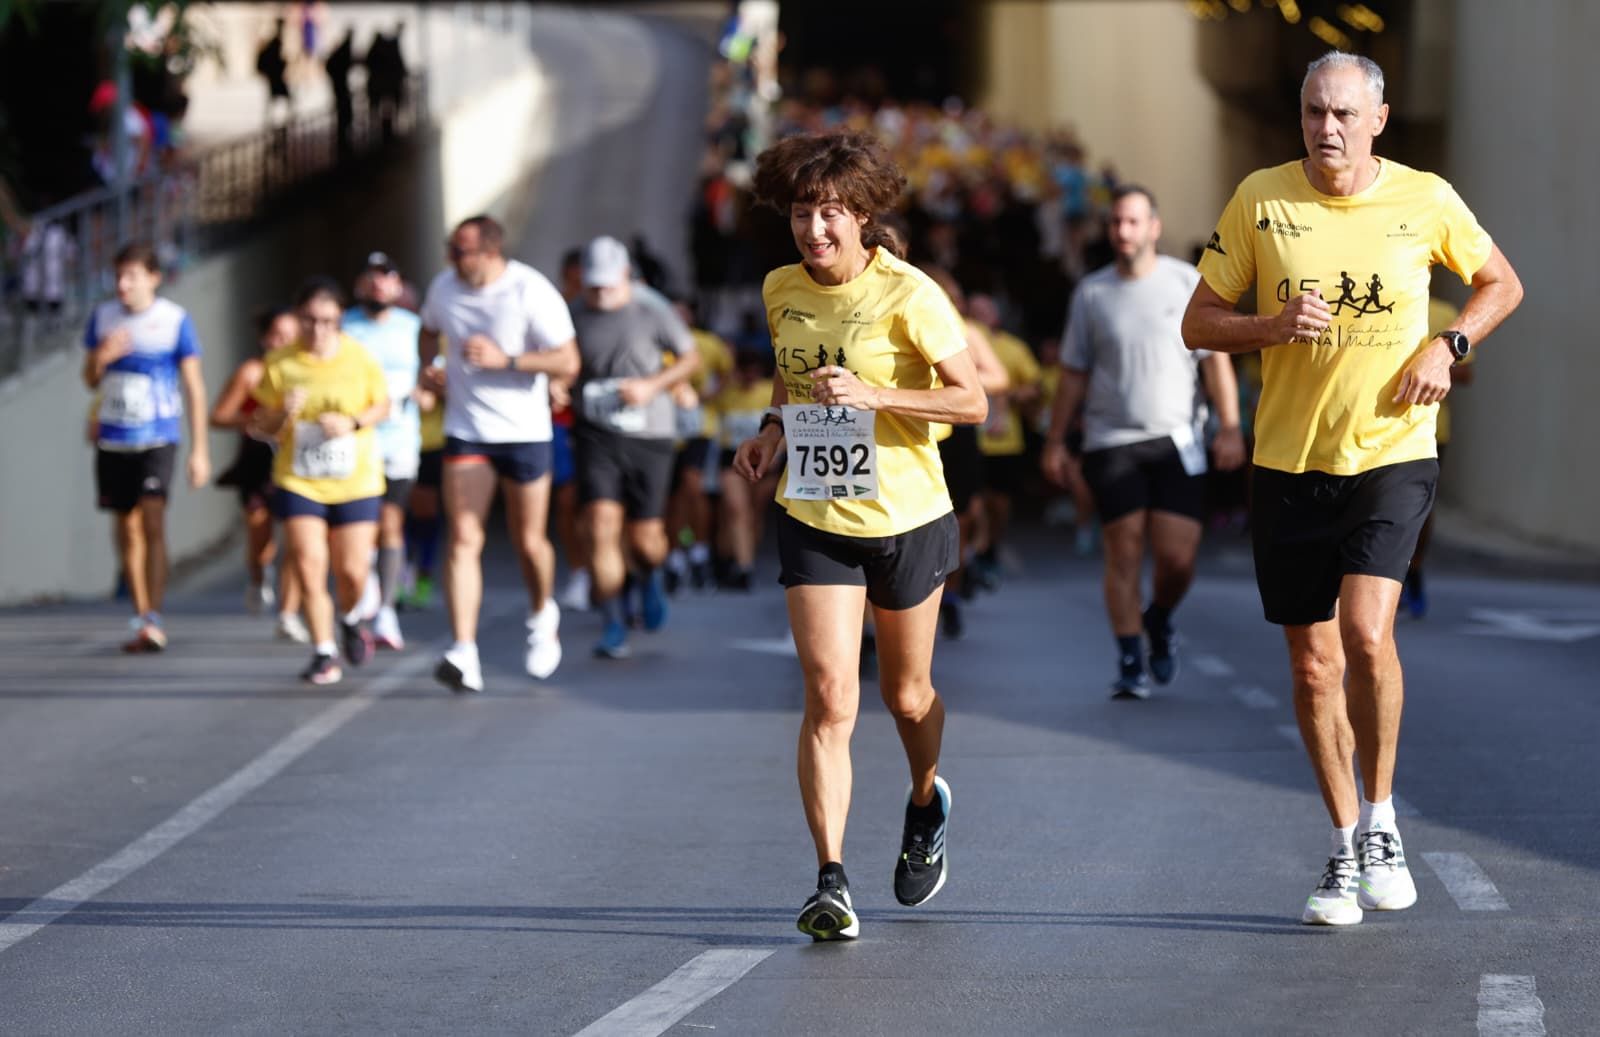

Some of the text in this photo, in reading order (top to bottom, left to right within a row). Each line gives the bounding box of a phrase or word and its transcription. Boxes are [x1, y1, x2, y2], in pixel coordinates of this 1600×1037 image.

[1271, 227, 1301, 239] Unicaja
[1272, 219, 1313, 232] Fundación
[777, 346, 809, 375] 45
[796, 410, 820, 425] 45
[795, 443, 871, 477] 7592
